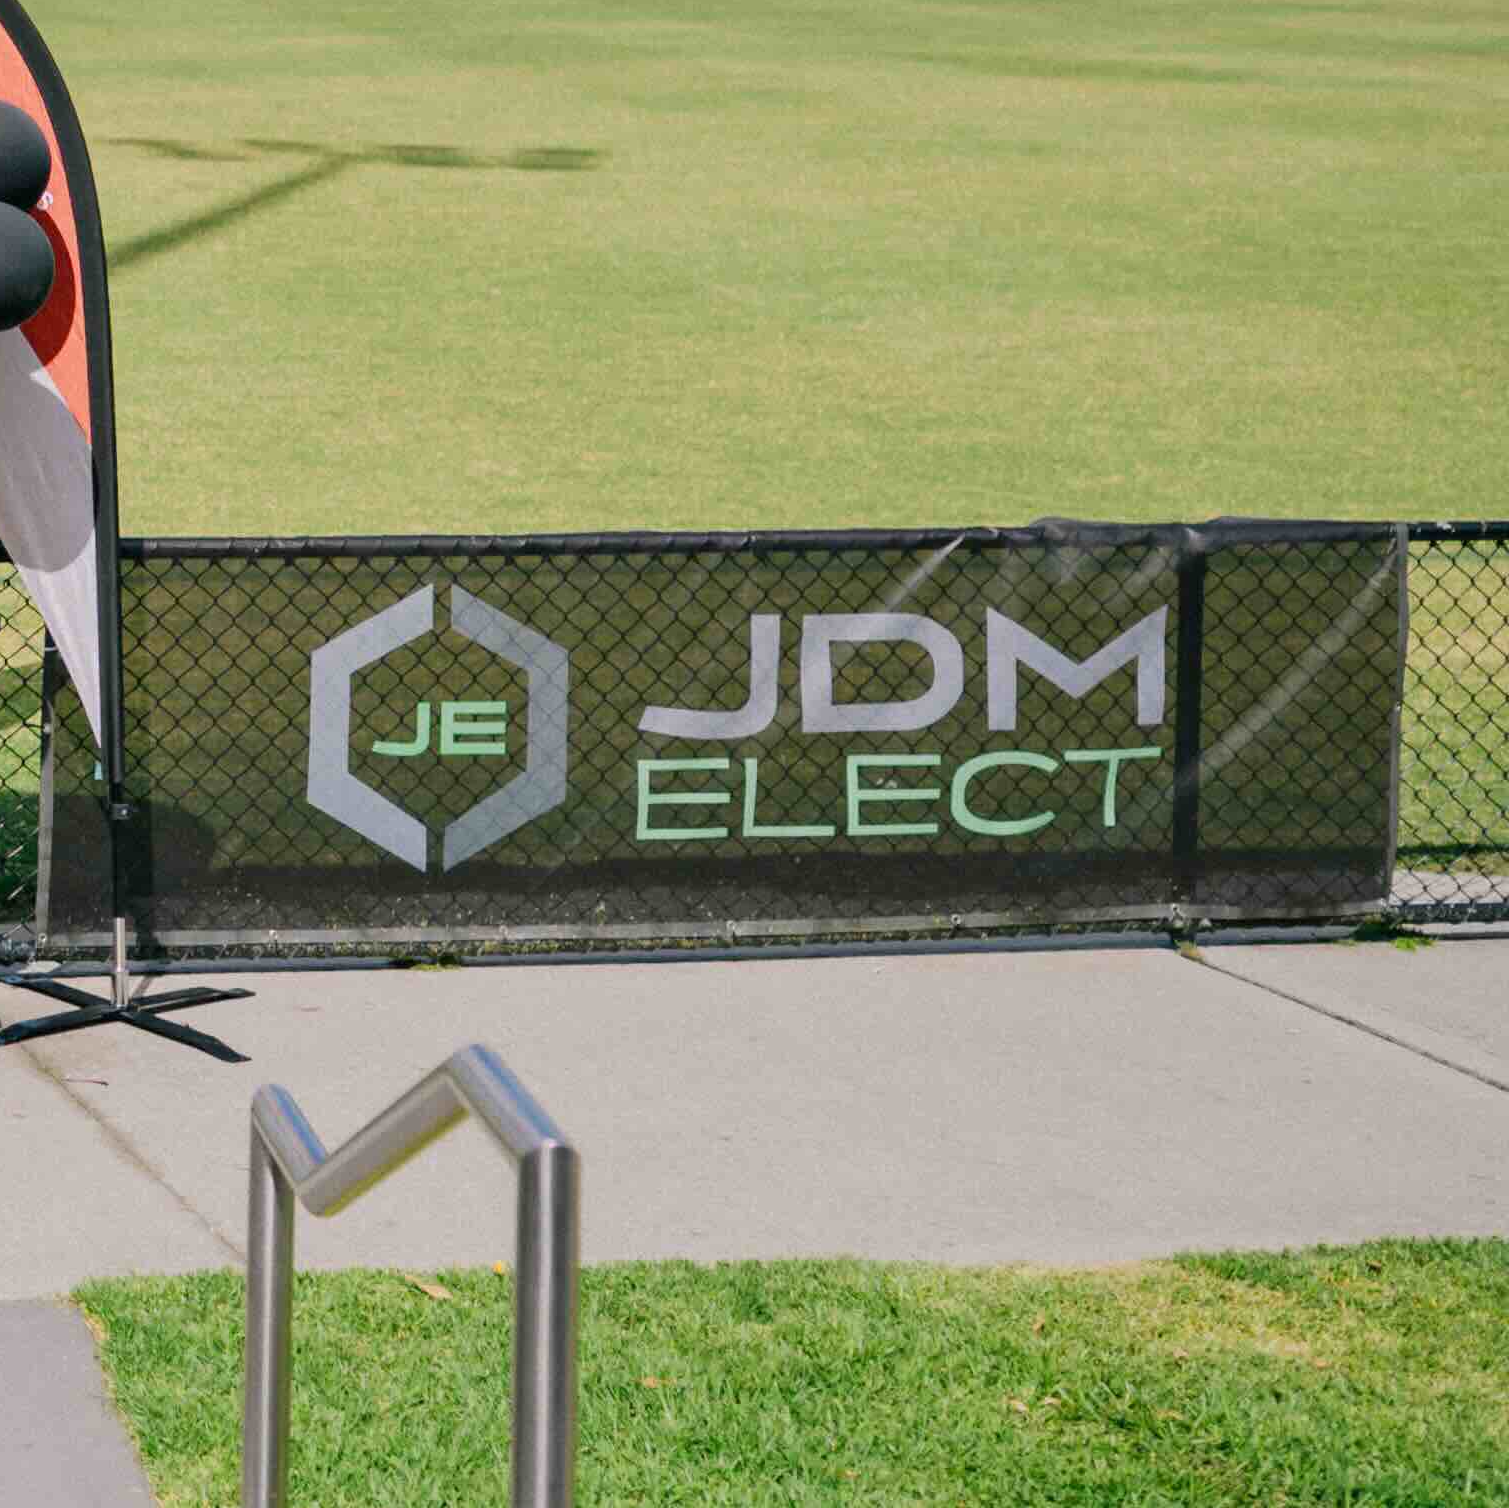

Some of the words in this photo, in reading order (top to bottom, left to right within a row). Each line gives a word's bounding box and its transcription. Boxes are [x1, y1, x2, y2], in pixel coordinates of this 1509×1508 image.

[637, 603, 1169, 742] JDM
[371, 700, 508, 757] JE
[635, 745, 1164, 842] ELECT
